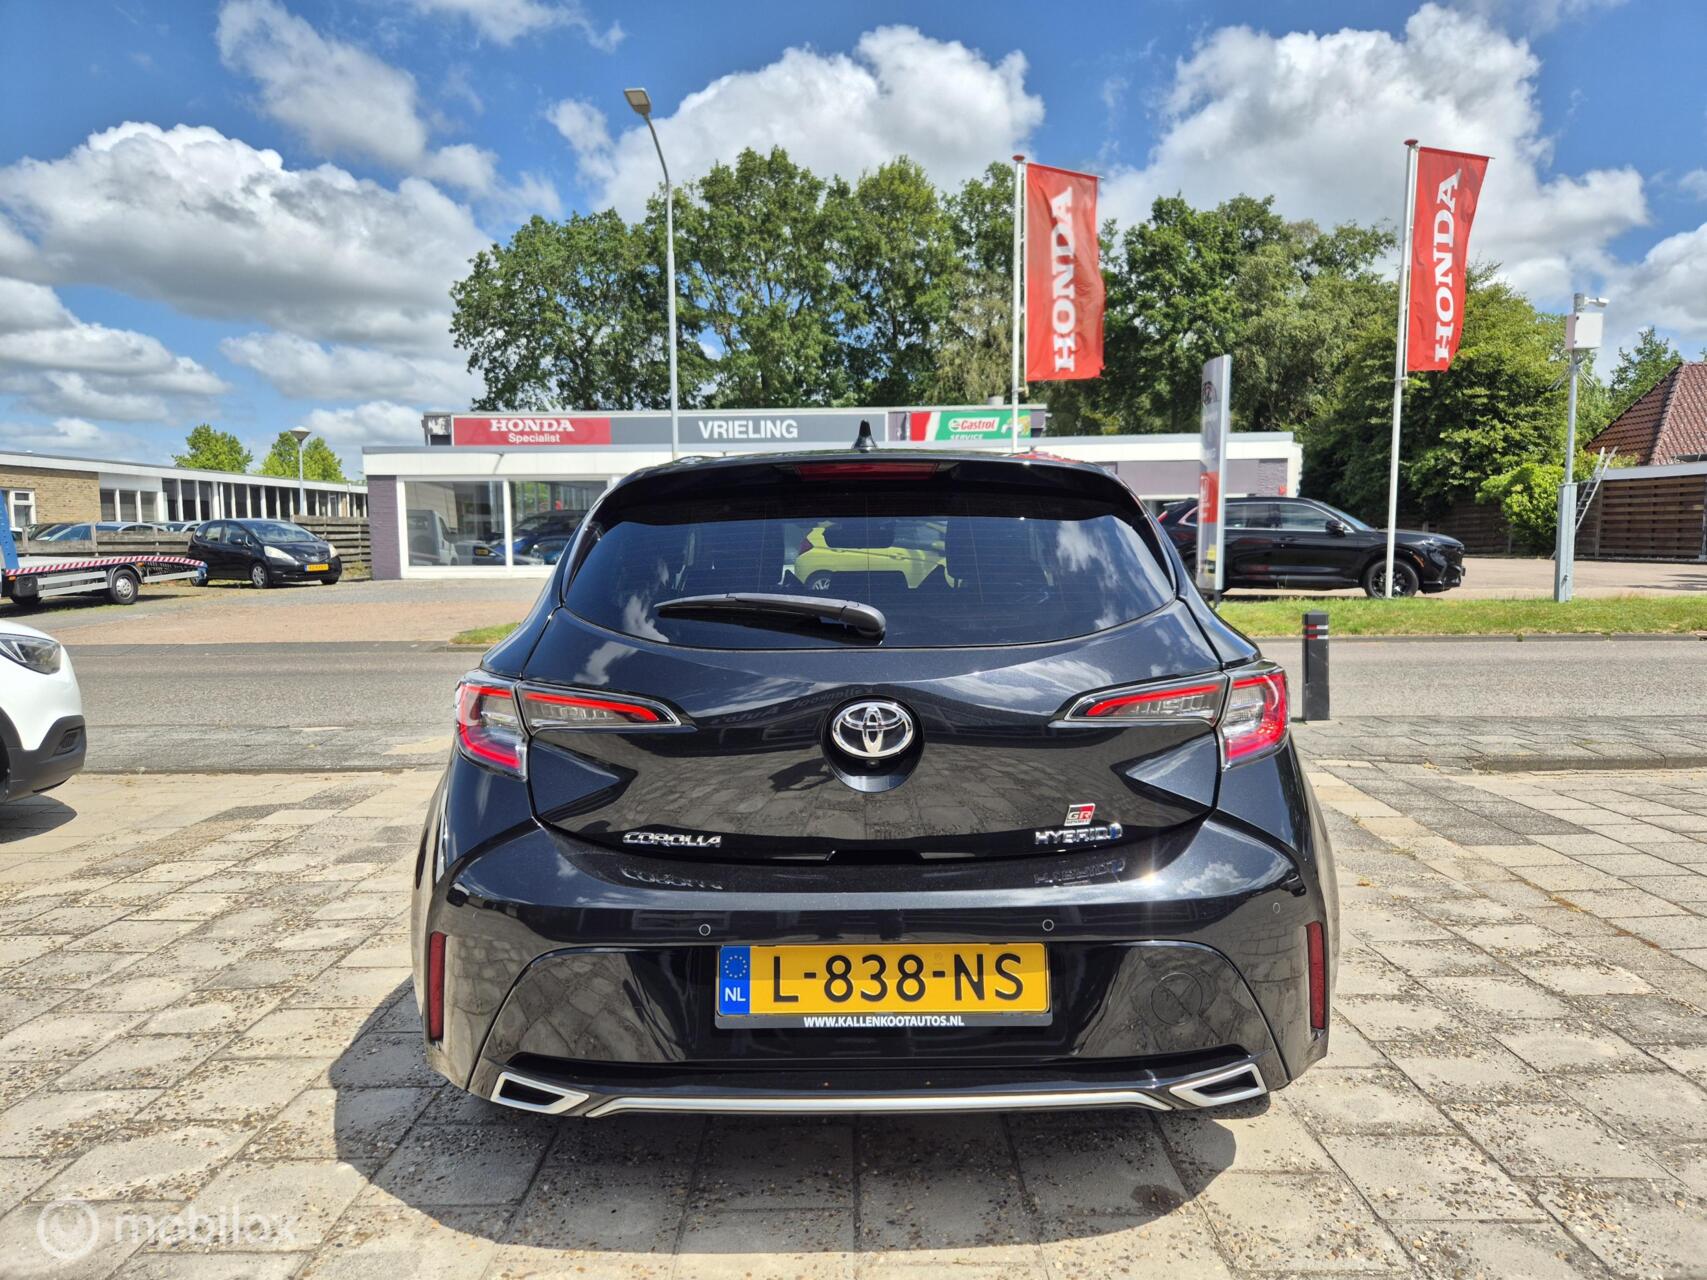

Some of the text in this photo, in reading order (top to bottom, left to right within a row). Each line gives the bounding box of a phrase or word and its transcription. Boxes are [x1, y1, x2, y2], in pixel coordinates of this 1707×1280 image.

[1433, 168, 1462, 363] HONDA
[1050, 186, 1076, 373] HONDA
[490, 419, 575, 432] HONDA
[698, 419, 798, 439] VRIELING
[960, 420, 996, 430] Castrol
[508, 433, 561, 443] Specialist
[1067, 810, 1092, 820] GR
[622, 832, 721, 848] COROLLA
[1035, 826, 1108, 845] HYBRID
[773, 953, 1024, 1003] L-838-NS
[725, 987, 746, 1001] NL
[803, 1015, 965, 1027] WWW.KALLENKOOTAUTOS.NL
